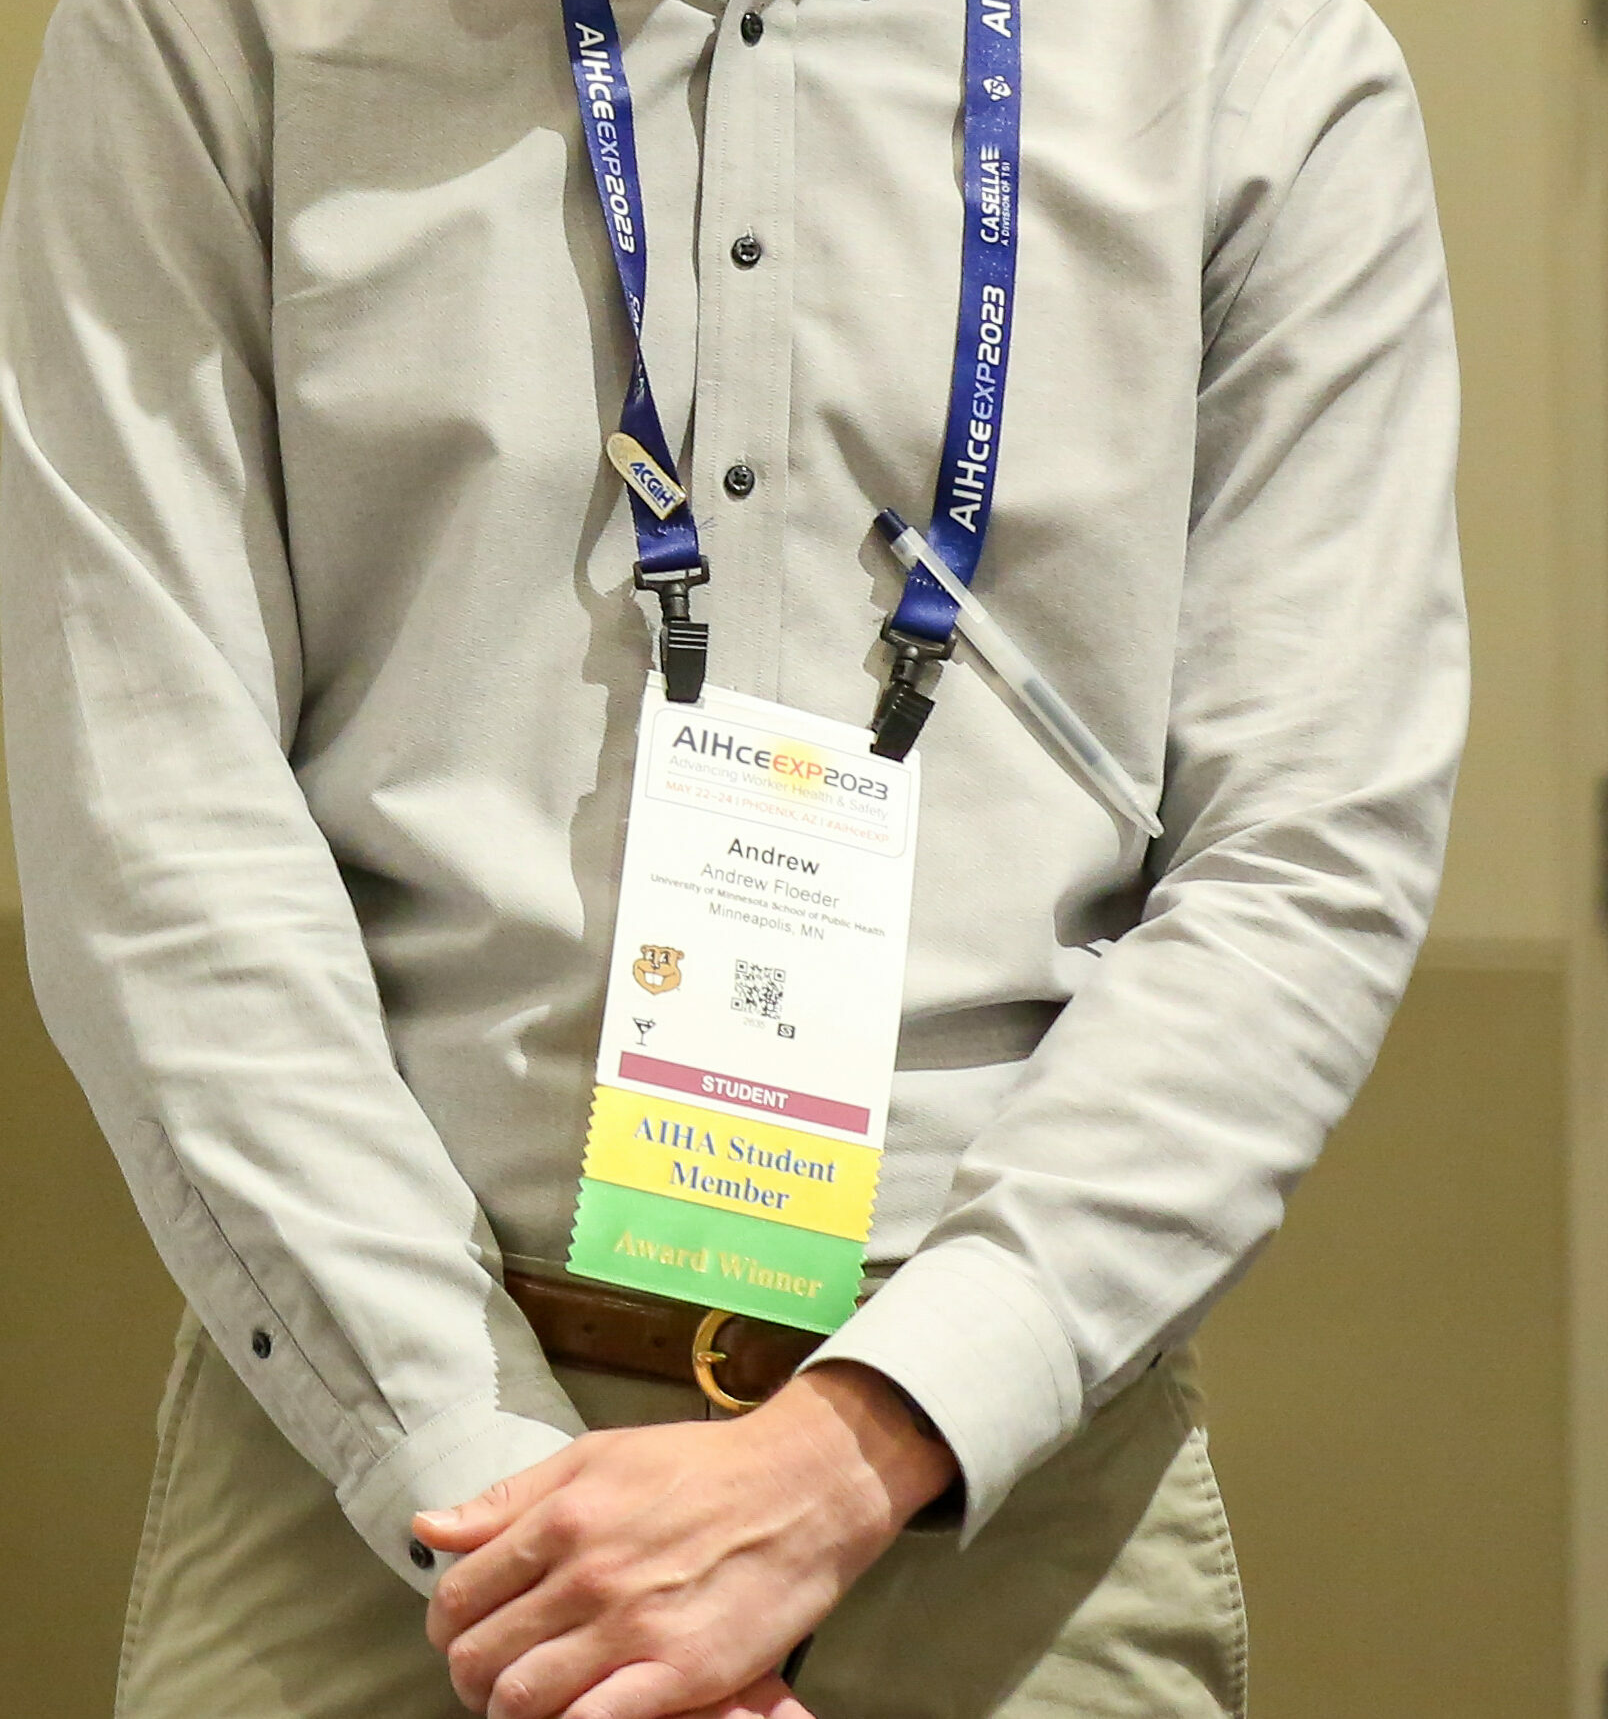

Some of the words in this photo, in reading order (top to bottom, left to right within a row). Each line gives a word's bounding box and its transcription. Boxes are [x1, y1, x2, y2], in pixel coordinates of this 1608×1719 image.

[574, 22, 636, 255] AIHceEXP2023
[980, 160, 1000, 243] CASELLA
[1001, 181, 1011, 194] OF
[1000, 237, 1009, 246] A
[948, 284, 1006, 534] AIHceEXP2023
[628, 460, 676, 509] ACGIH
[669, 754, 739, 783] Advancing
[741, 771, 789, 793] Worker
[792, 782, 835, 805] Health
[836, 793, 848, 809] &
[848, 797, 890, 821] Safety
[671, 725, 889, 801] AIHceEXP2023
[727, 837, 820, 876] Andrew
[649, 873, 702, 895] University
[703, 886, 715, 895] of
[716, 887, 769, 909] Minnesota
[771, 901, 807, 917] School
[807, 911, 819, 921] of
[820, 913, 851, 929] Public
[853, 921, 885, 937] Health
[699, 862, 769, 891] Andrew
[773, 878, 841, 909] Floeder
[708, 901, 796, 936] Minneapolis,
[799, 923, 825, 941] MN
[701, 1075, 789, 1109] STUDENT
[634, 1117, 716, 1156] AIHA
[727, 1136, 837, 1184] Student
[670, 1161, 790, 1210] Member
[613, 1230, 708, 1274] Award
[718, 1251, 824, 1299] Winner
